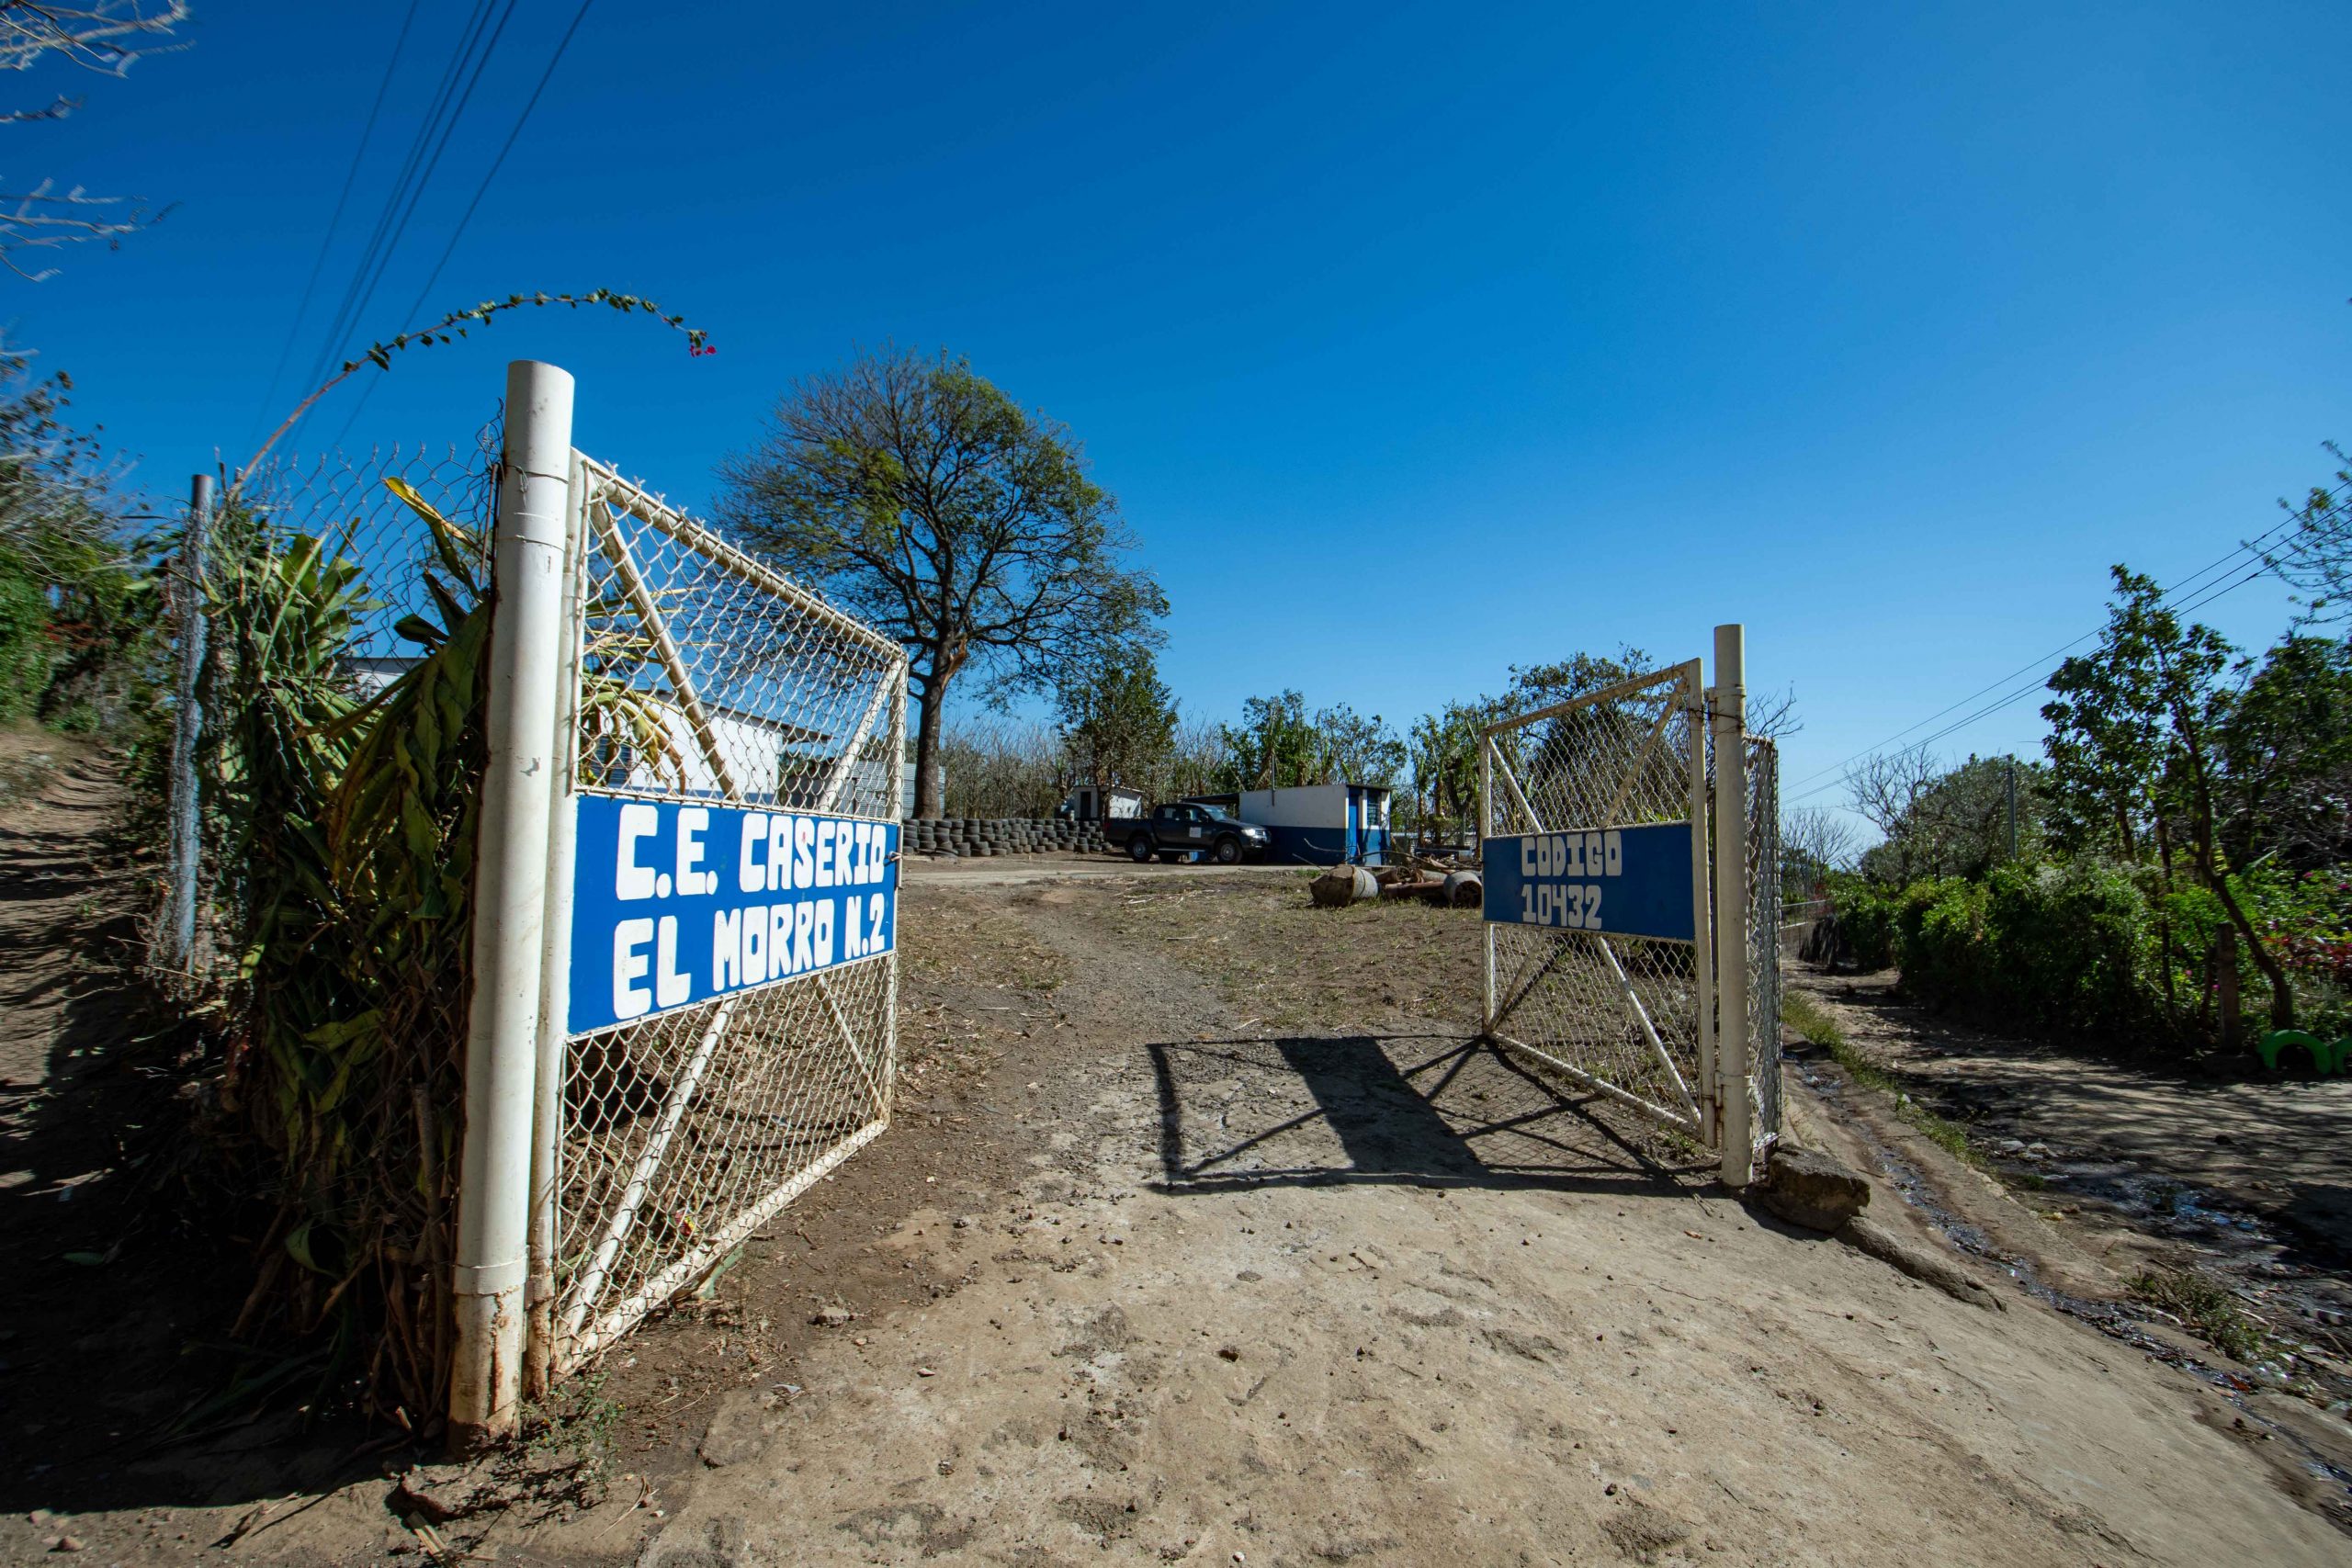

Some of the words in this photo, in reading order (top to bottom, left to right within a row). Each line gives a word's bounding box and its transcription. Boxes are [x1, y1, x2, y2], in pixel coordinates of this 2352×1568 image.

[616, 804, 718, 900] C.E.
[739, 812, 887, 893] CASERIO
[1521, 830, 1622, 876] CODIGO
[1521, 885, 1602, 930] 10432
[613, 915, 692, 1020] EL
[712, 898, 835, 992] MORRO
[844, 892, 885, 960] N.2
